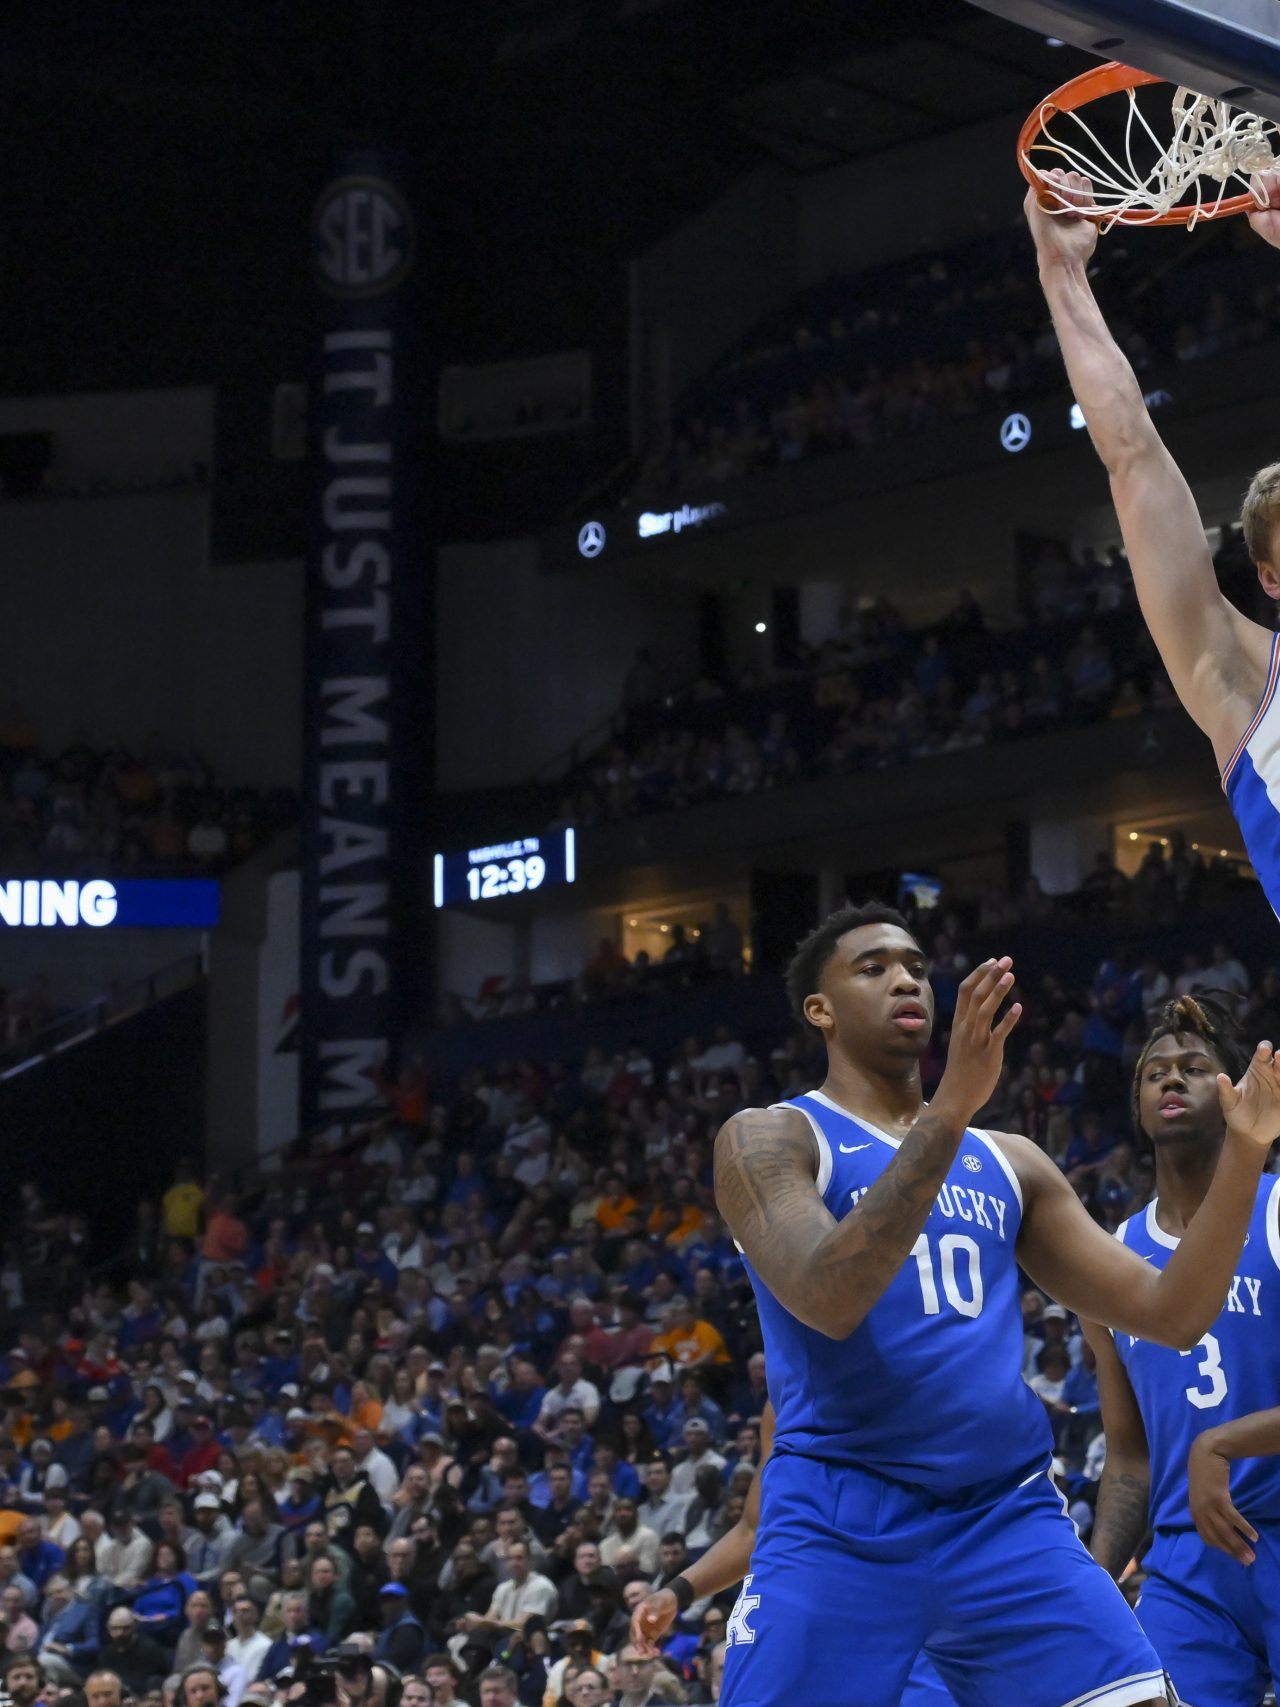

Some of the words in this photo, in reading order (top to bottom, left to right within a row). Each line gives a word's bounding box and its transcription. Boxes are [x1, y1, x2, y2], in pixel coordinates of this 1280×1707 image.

[319, 191, 402, 283] SEC
[322, 329, 395, 408] IT
[321, 422, 394, 644] JUST
[318, 675, 391, 999] MEANS
[466, 855, 546, 901] 12:39
[962, 1155, 982, 1172] SEC
[909, 1233, 984, 1319] 10
[1179, 1332, 1228, 1410] 3
